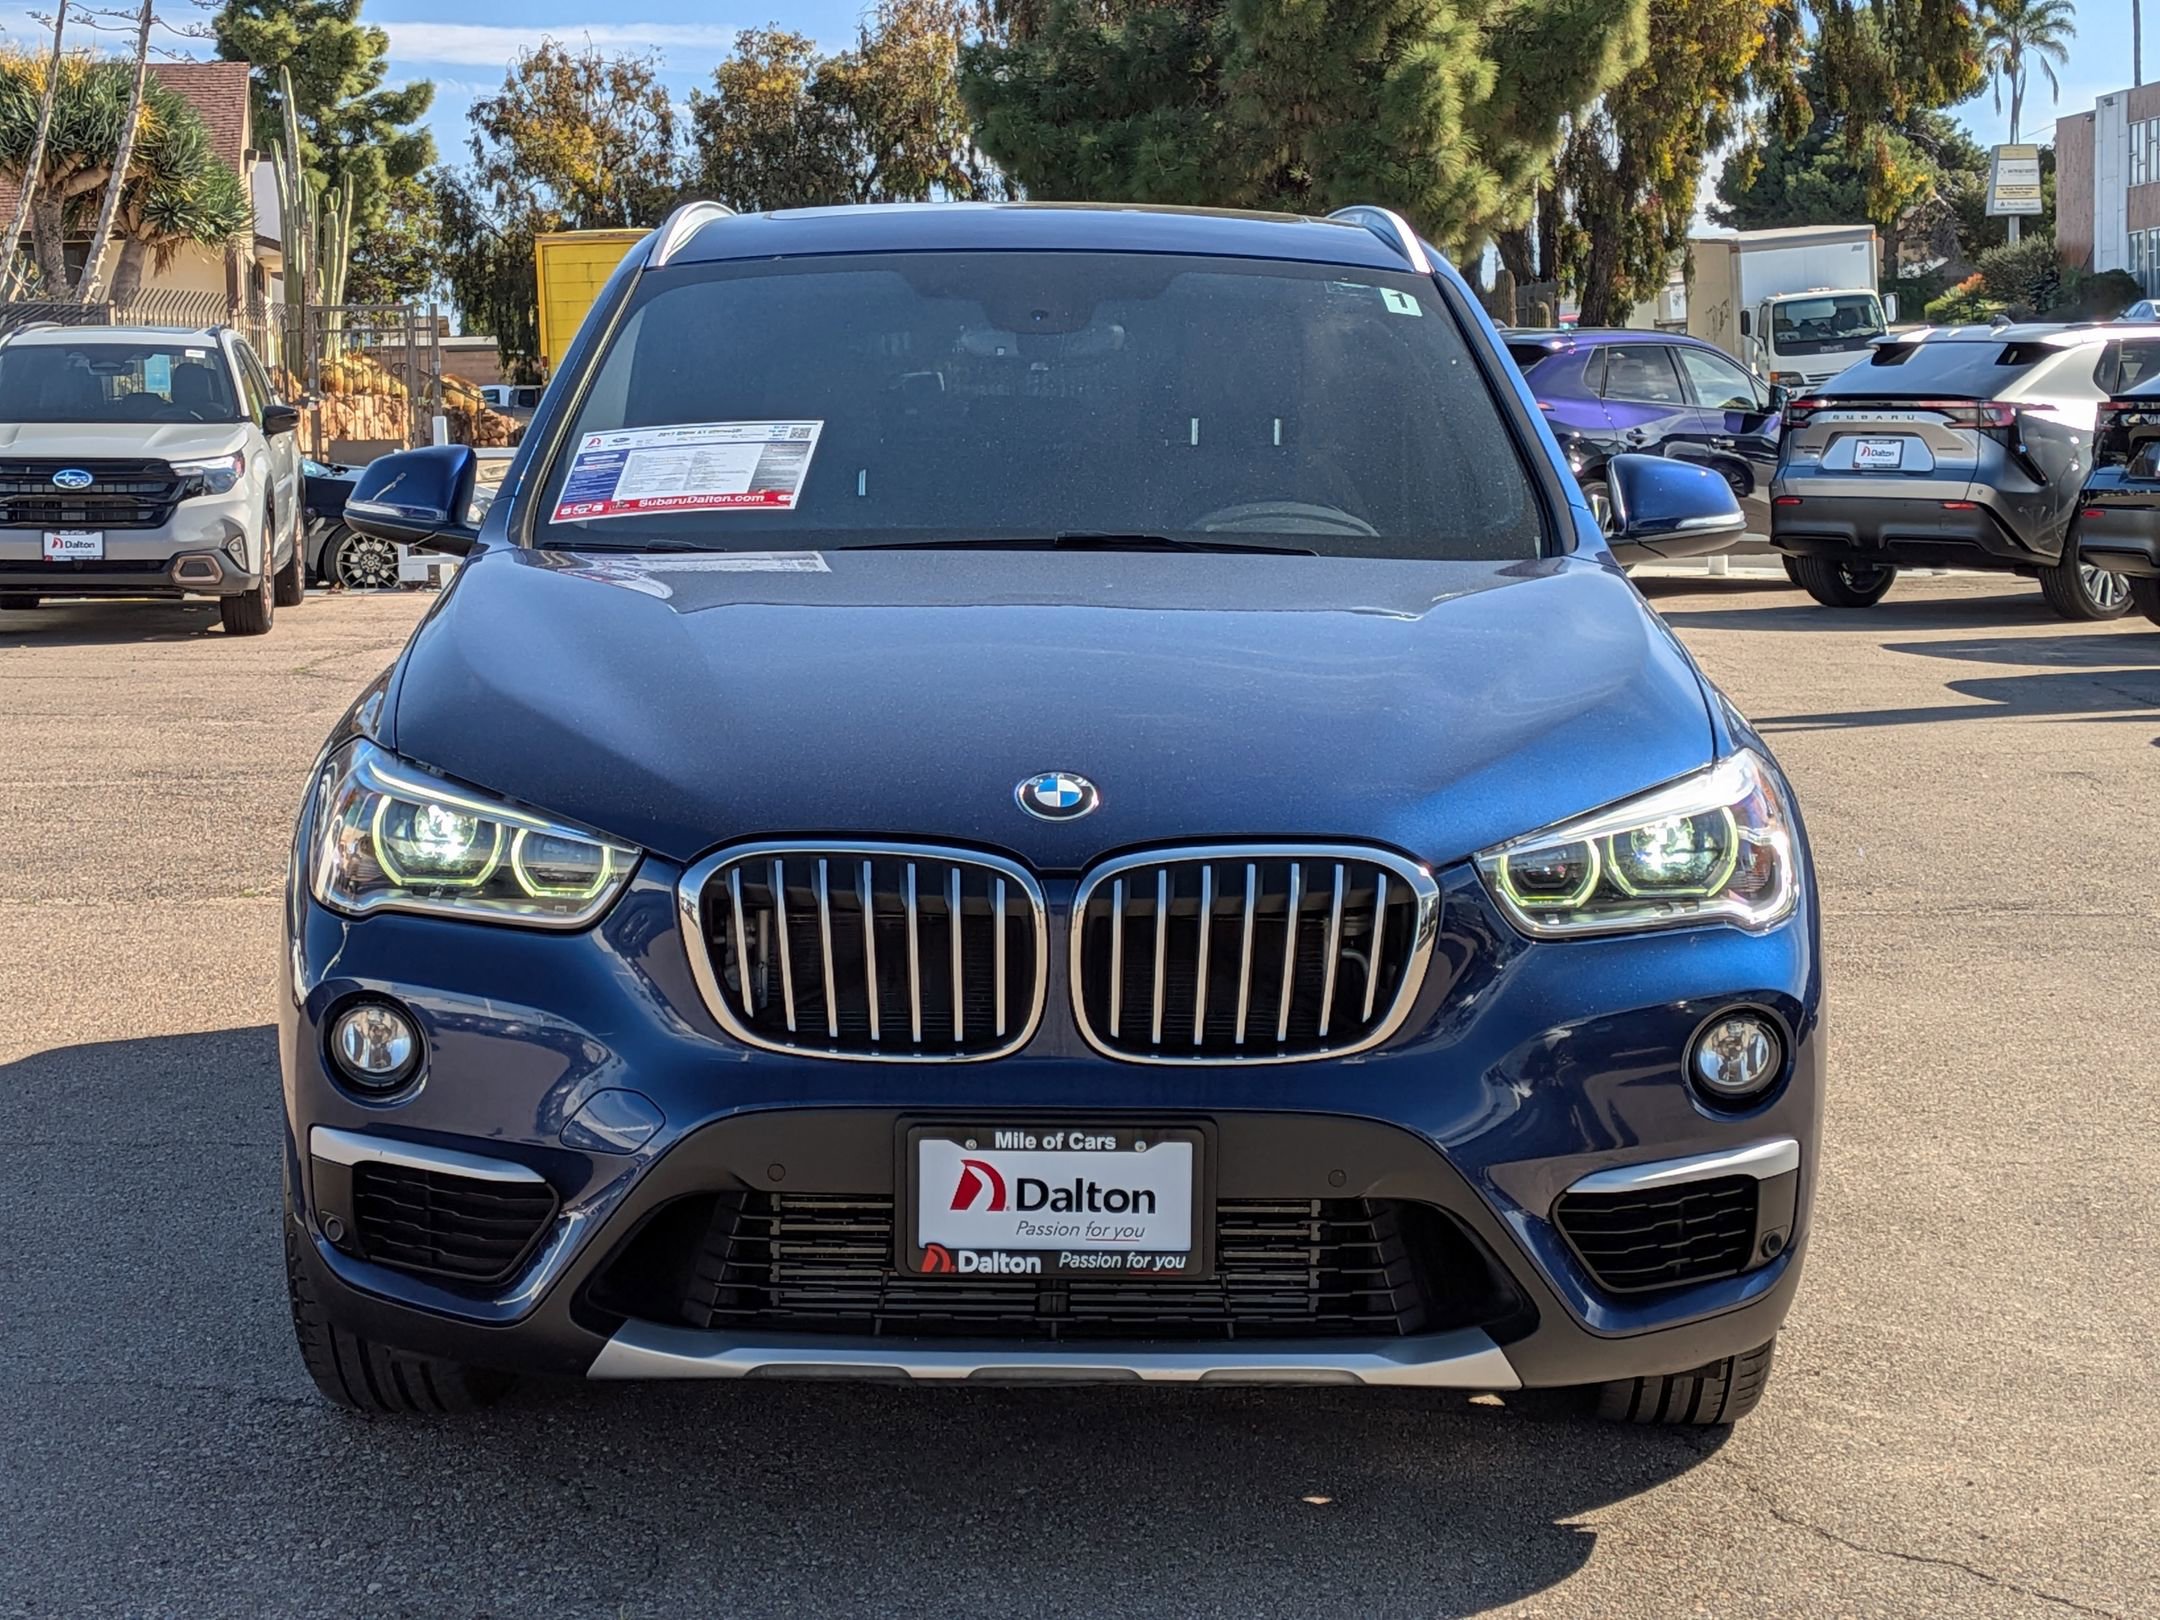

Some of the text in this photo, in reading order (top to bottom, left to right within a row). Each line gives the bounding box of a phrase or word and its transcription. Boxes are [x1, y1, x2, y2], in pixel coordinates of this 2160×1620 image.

[638, 493, 765, 508] SubaruDalton.com
[65, 541, 95, 549] Dalton
[995, 1131, 1117, 1151] Mile of Cars
[1016, 1177, 1156, 1215] Dalton
[1016, 1220, 1146, 1241] Passion for you
[958, 1250, 1187, 1274] Dalton Passion for you
